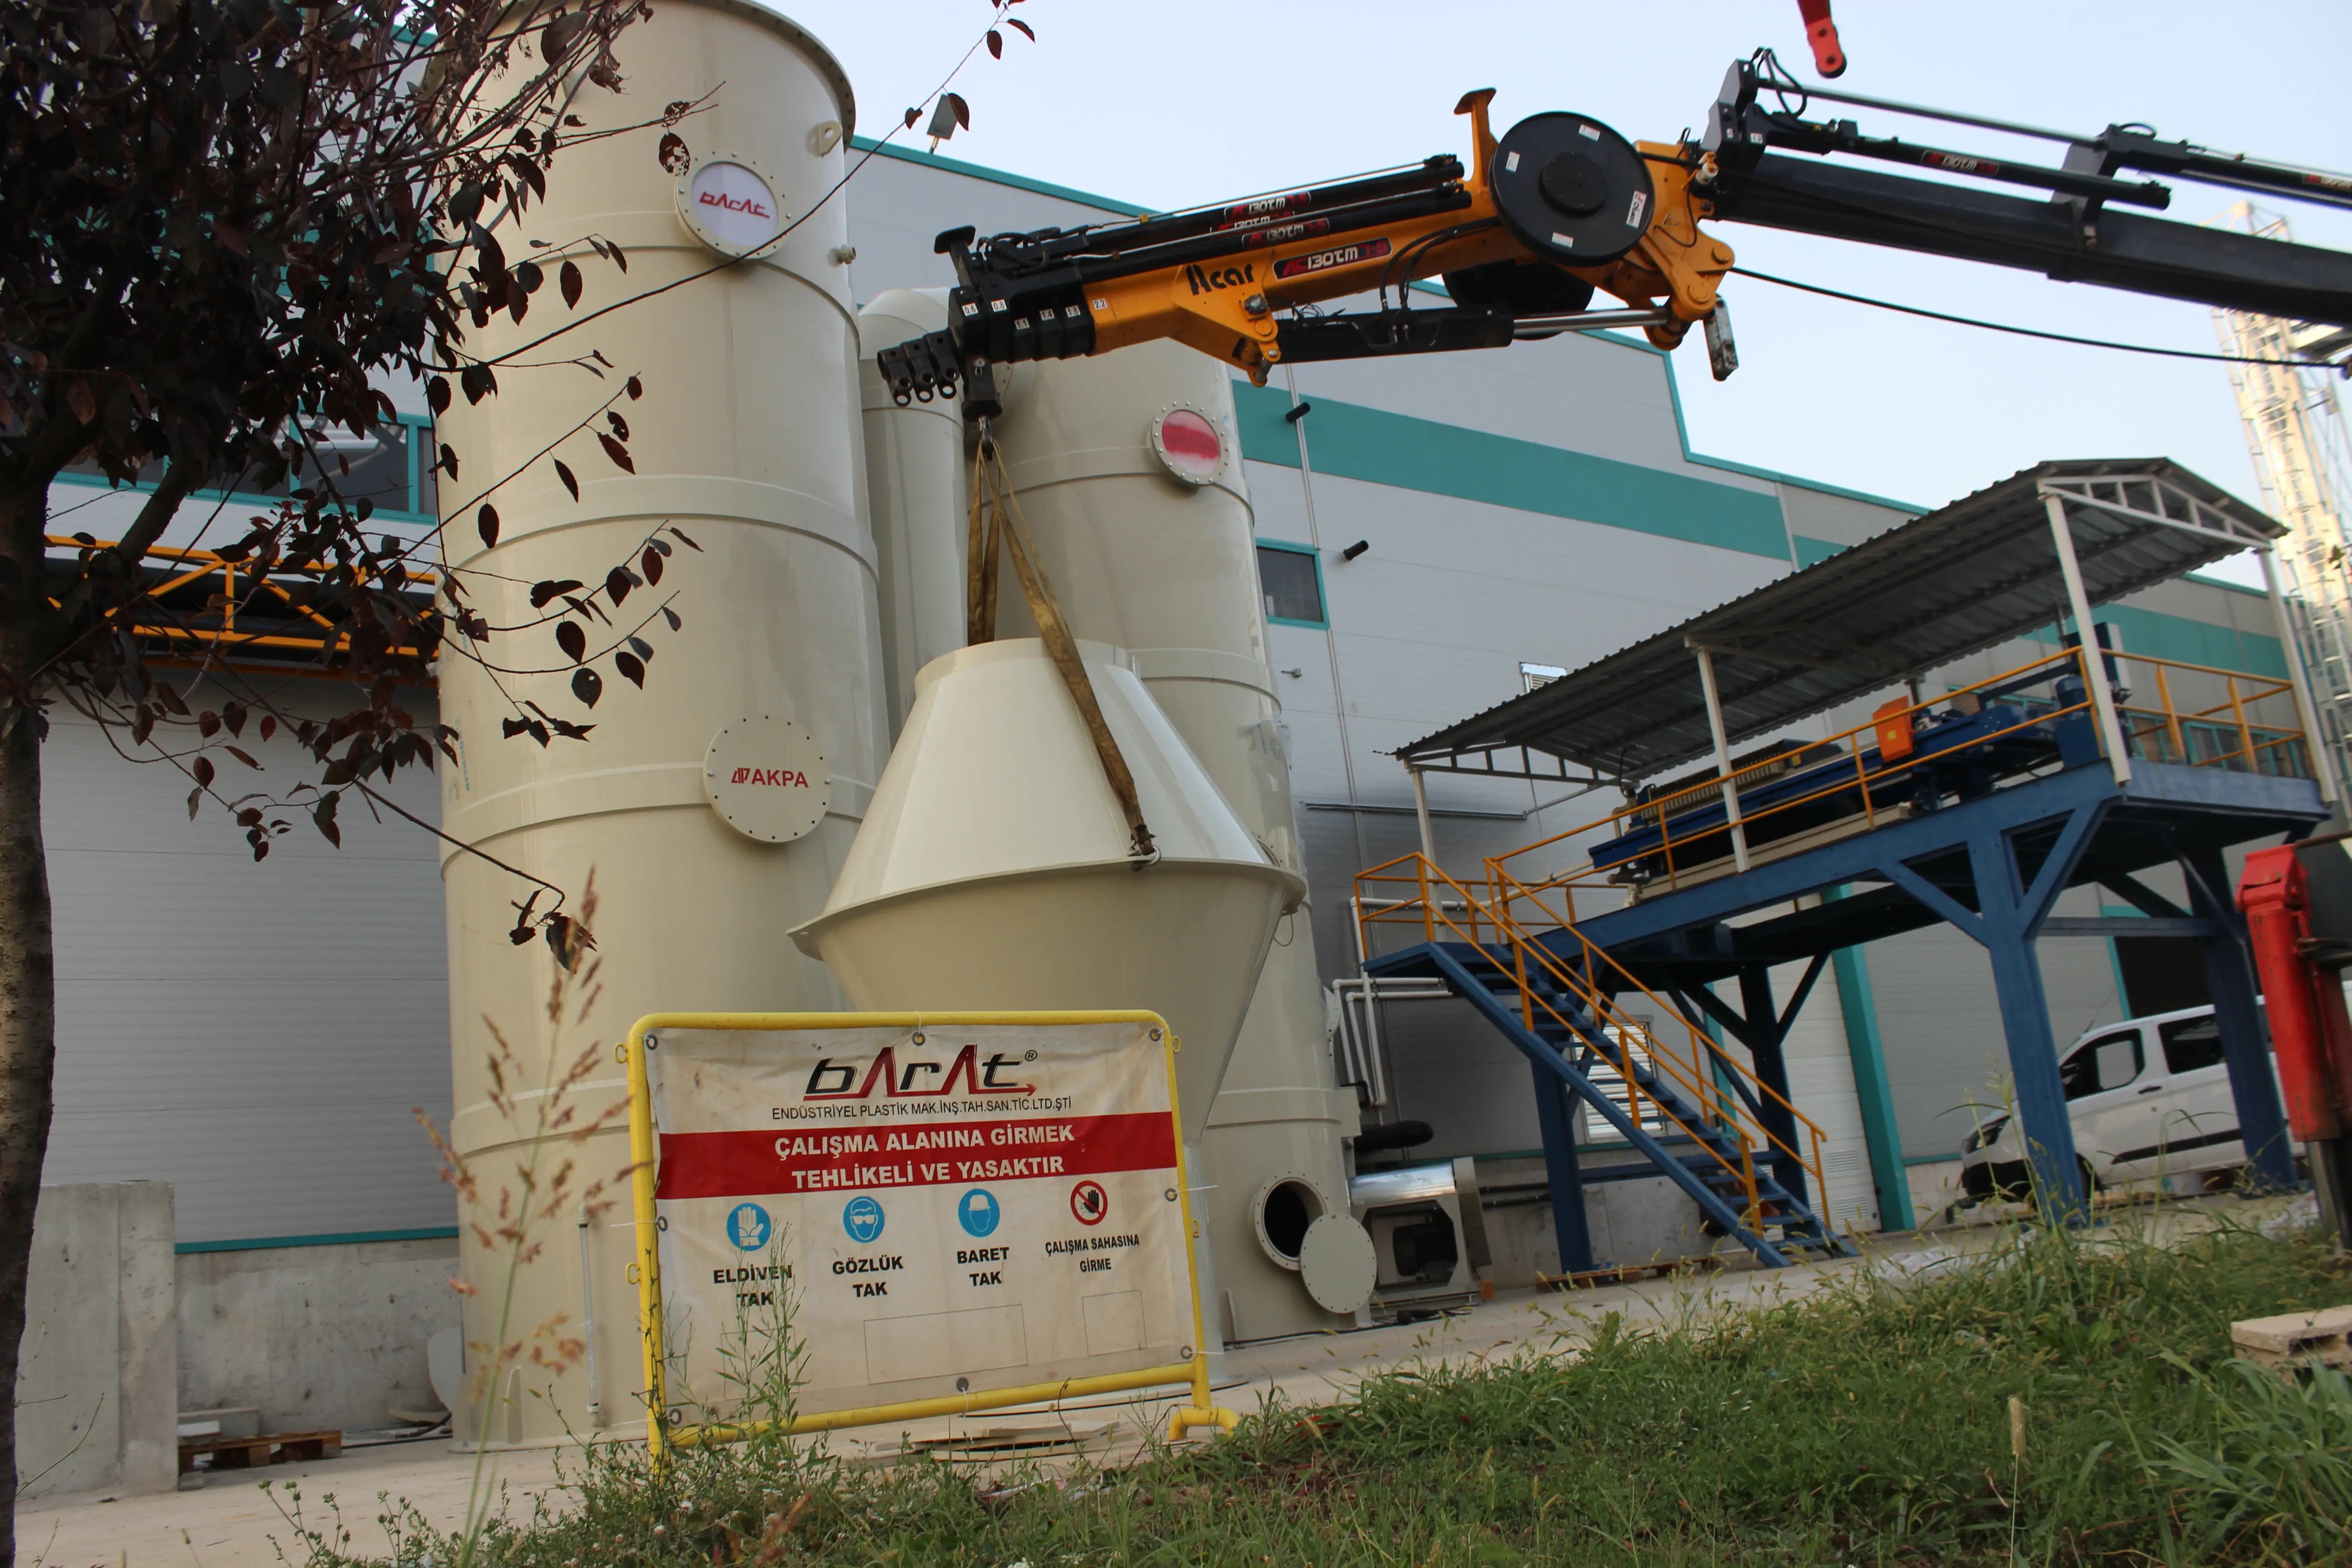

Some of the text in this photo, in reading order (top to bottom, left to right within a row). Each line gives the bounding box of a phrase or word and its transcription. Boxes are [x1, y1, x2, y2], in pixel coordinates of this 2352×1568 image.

[1186, 263, 1254, 296] Acar
[964, 305, 975, 314] 0.6
[994, 302, 1005, 311] 0.8
[1067, 307, 1078, 316] 1.8
[1094, 299, 1106, 309] 2.2
[1042, 311, 1053, 319] 1.4
[1016, 320, 1028, 328] 1.1
[751, 769, 808, 788] AKPA
[772, 1104, 857, 1119] ENDÜSTRİYEL
[861, 1102, 908, 1116] PLASTİK
[775, 1124, 1075, 1161] ÇALIŞMA ALANINA GİRMEK
[792, 1156, 1064, 1188] TEHLİKELİ VE YASAKTIR
[1045, 1234, 1139, 1257] ÇALIŞMA SAHASINA
[957, 1247, 1009, 1264] BARET
[832, 1254, 904, 1275] GÖZLÜK
[1080, 1258, 1112, 1272] GİRME
[713, 1264, 792, 1284] ELDİVEN
[970, 1271, 1002, 1286] TAK
[853, 1282, 888, 1297] TAK
[736, 1292, 774, 1307] TAK
